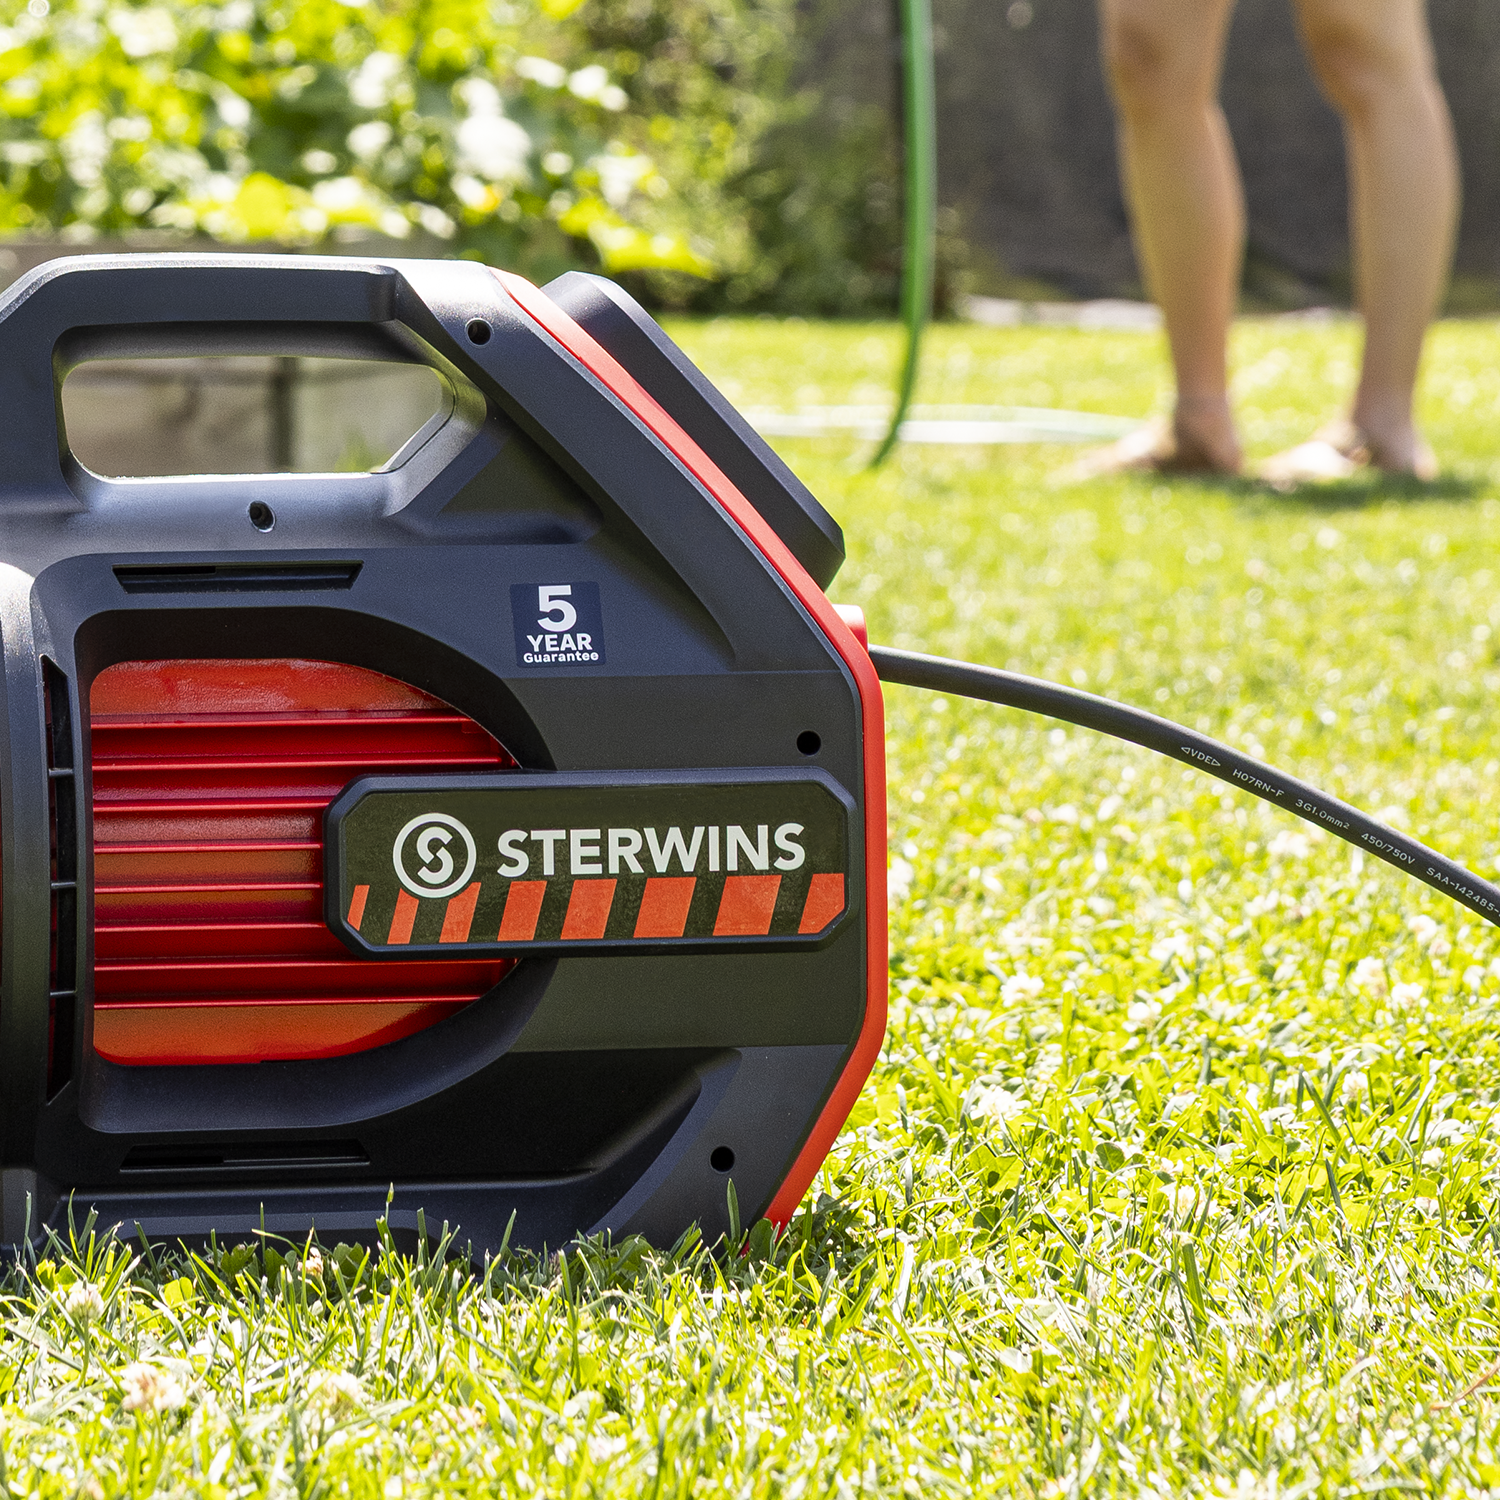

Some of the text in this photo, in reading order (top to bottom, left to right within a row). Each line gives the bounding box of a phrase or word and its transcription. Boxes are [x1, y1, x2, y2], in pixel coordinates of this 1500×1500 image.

[537, 584, 577, 632] 5
[523, 651, 599, 663] Guarantee
[526, 633, 593, 652] YEAR
[497, 822, 806, 878] STERWINS
[1232, 768, 1285, 798] H07RN-F
[1360, 832, 1416, 865] 450/750V
[1426, 867, 1500, 918] SAA-142485-
